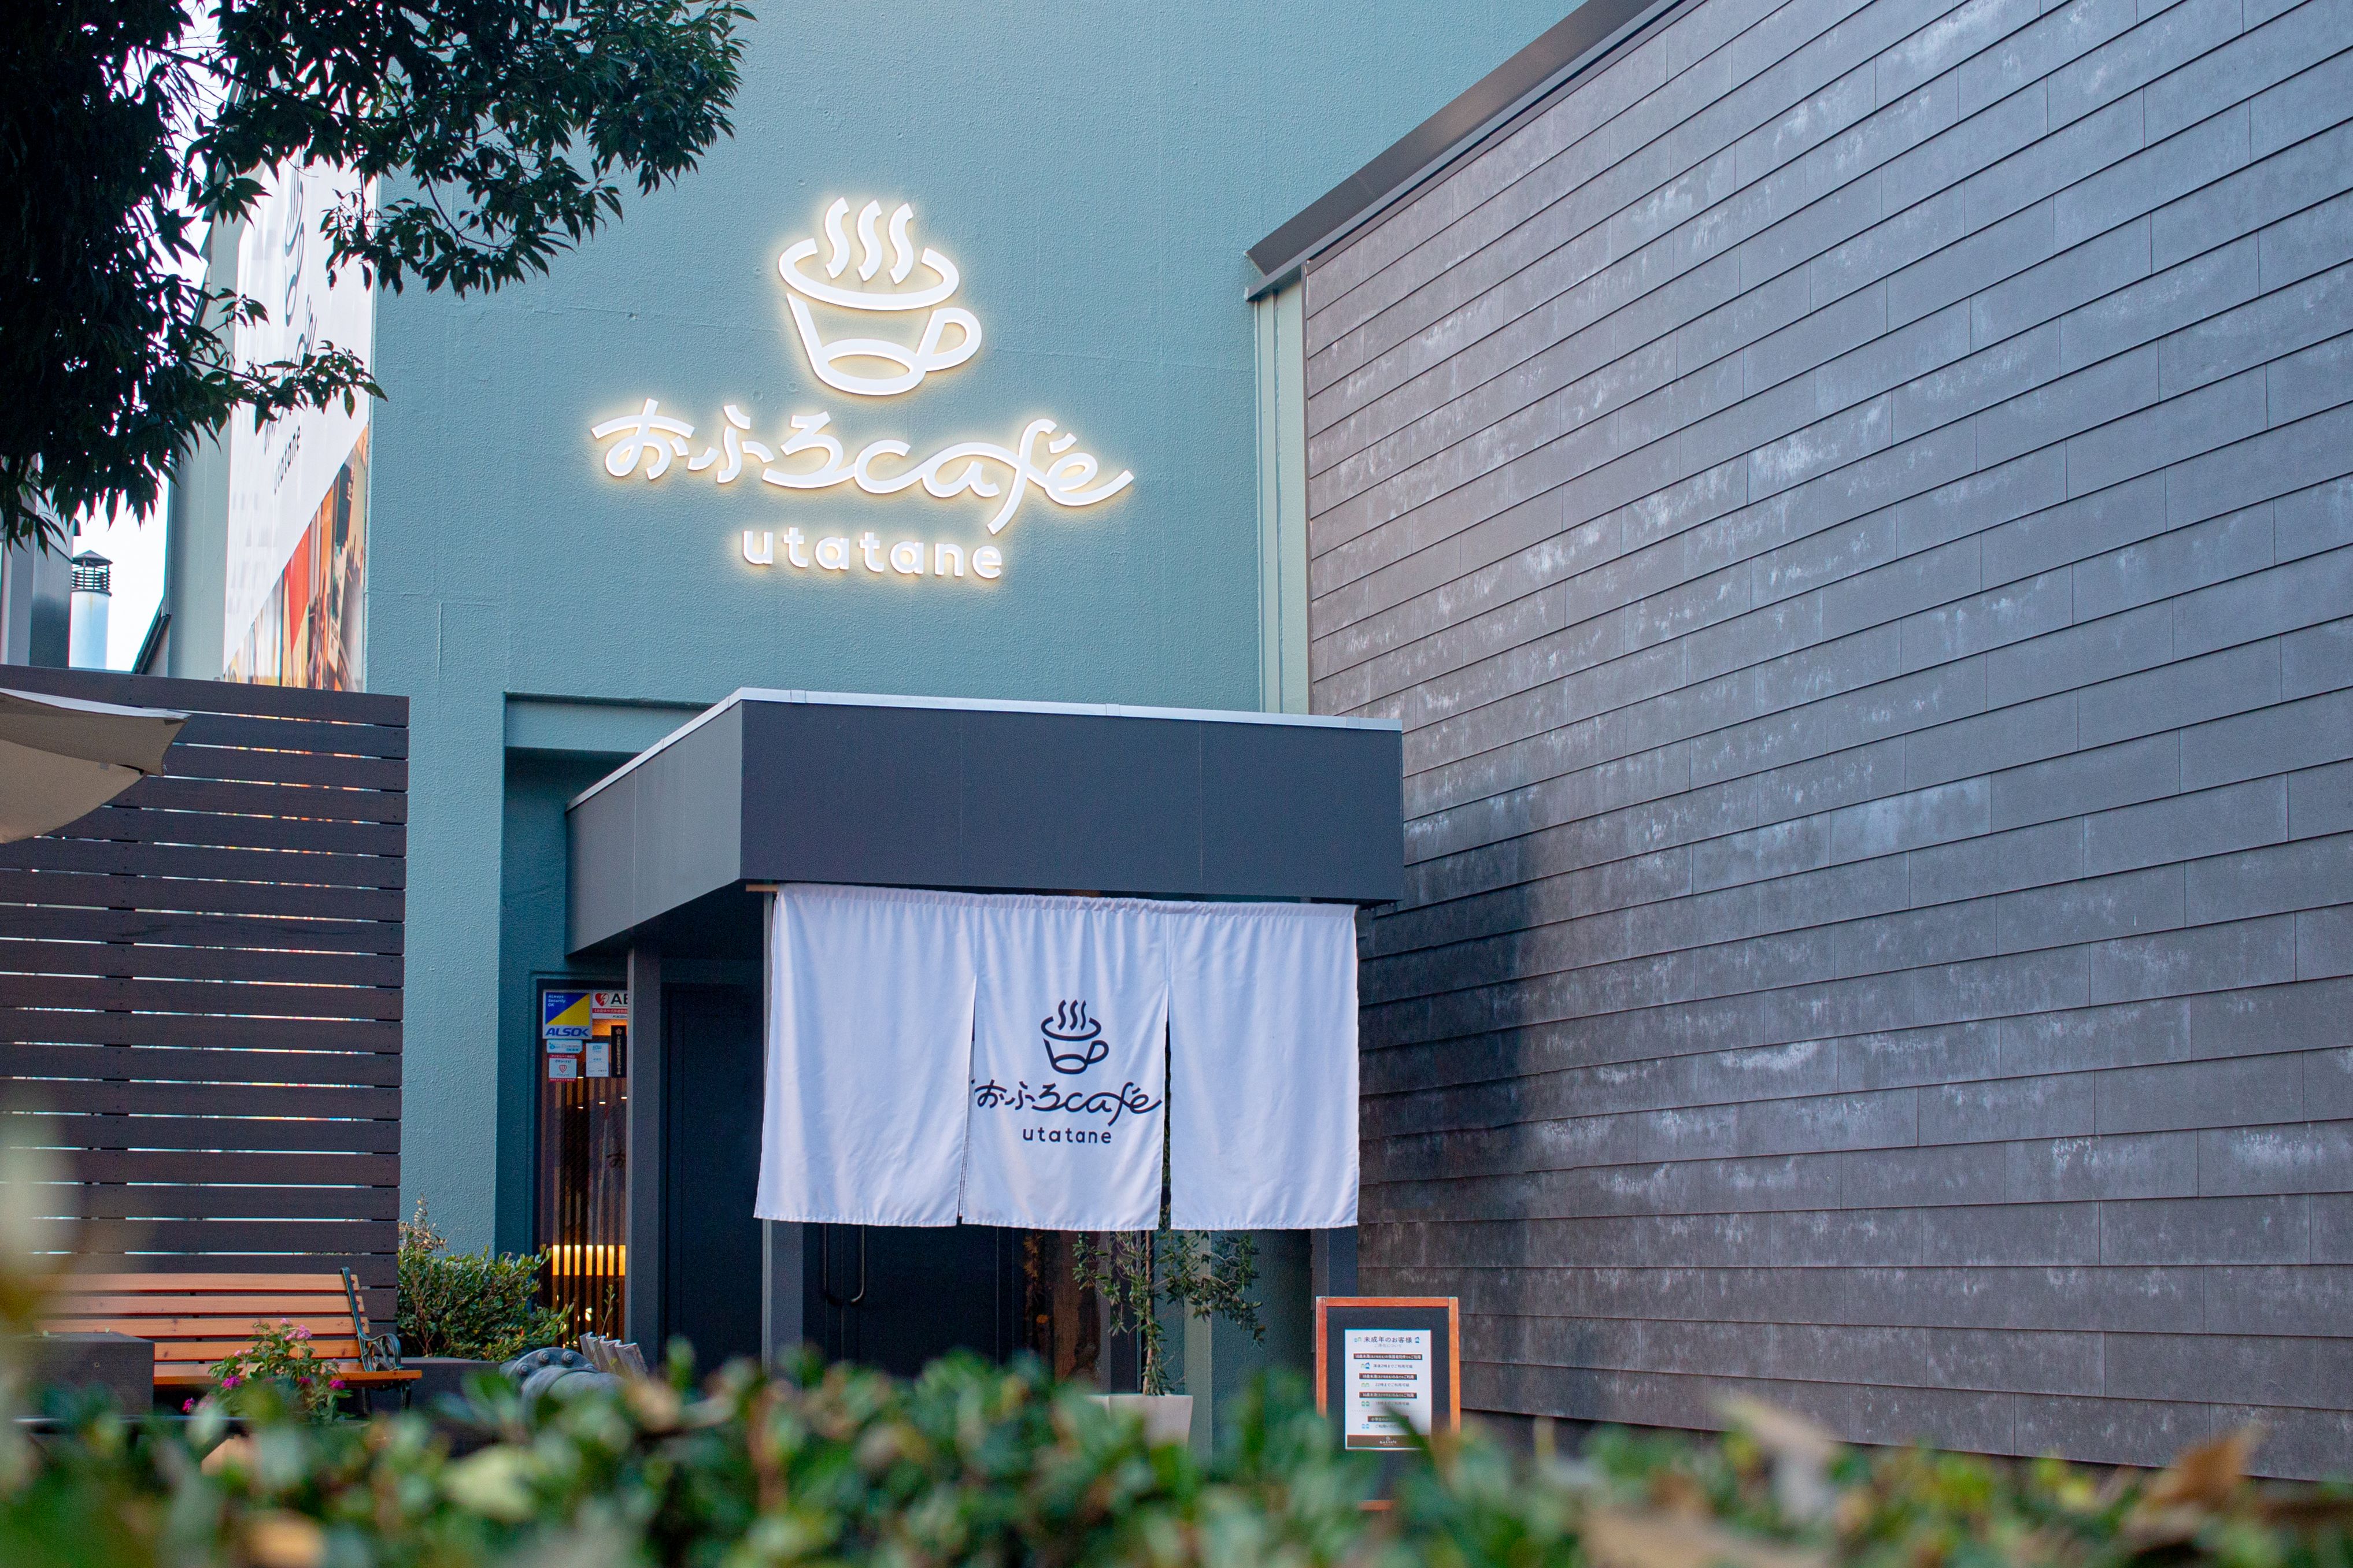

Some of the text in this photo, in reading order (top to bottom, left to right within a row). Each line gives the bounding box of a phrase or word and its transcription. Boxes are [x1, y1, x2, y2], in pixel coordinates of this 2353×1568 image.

[743, 527, 1002, 578] utatane
[545, 1028, 589, 1037] ALSOK
[1023, 1127, 1112, 1144] utatane
